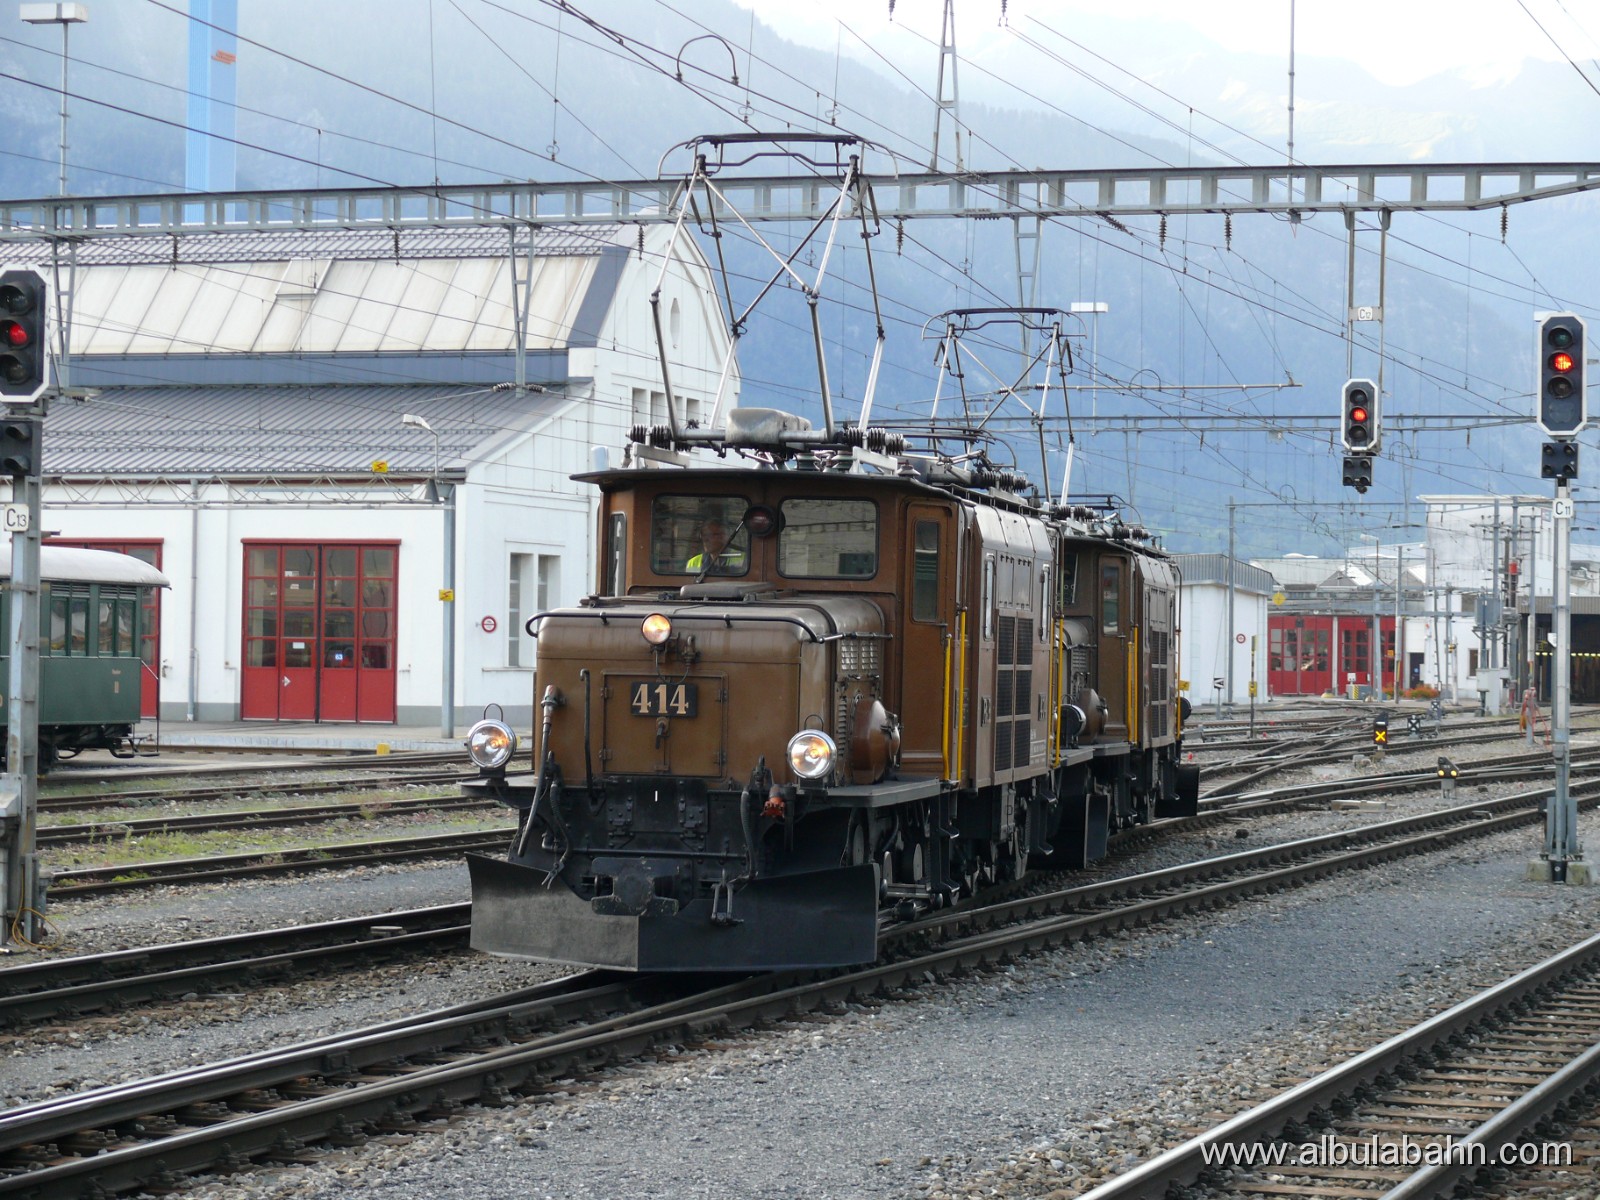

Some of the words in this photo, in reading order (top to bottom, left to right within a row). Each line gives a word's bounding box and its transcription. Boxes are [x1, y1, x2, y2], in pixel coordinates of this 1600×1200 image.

[6, 507, 27, 527] C13
[1555, 501, 1571, 516] C11
[632, 683, 689, 715] 414
